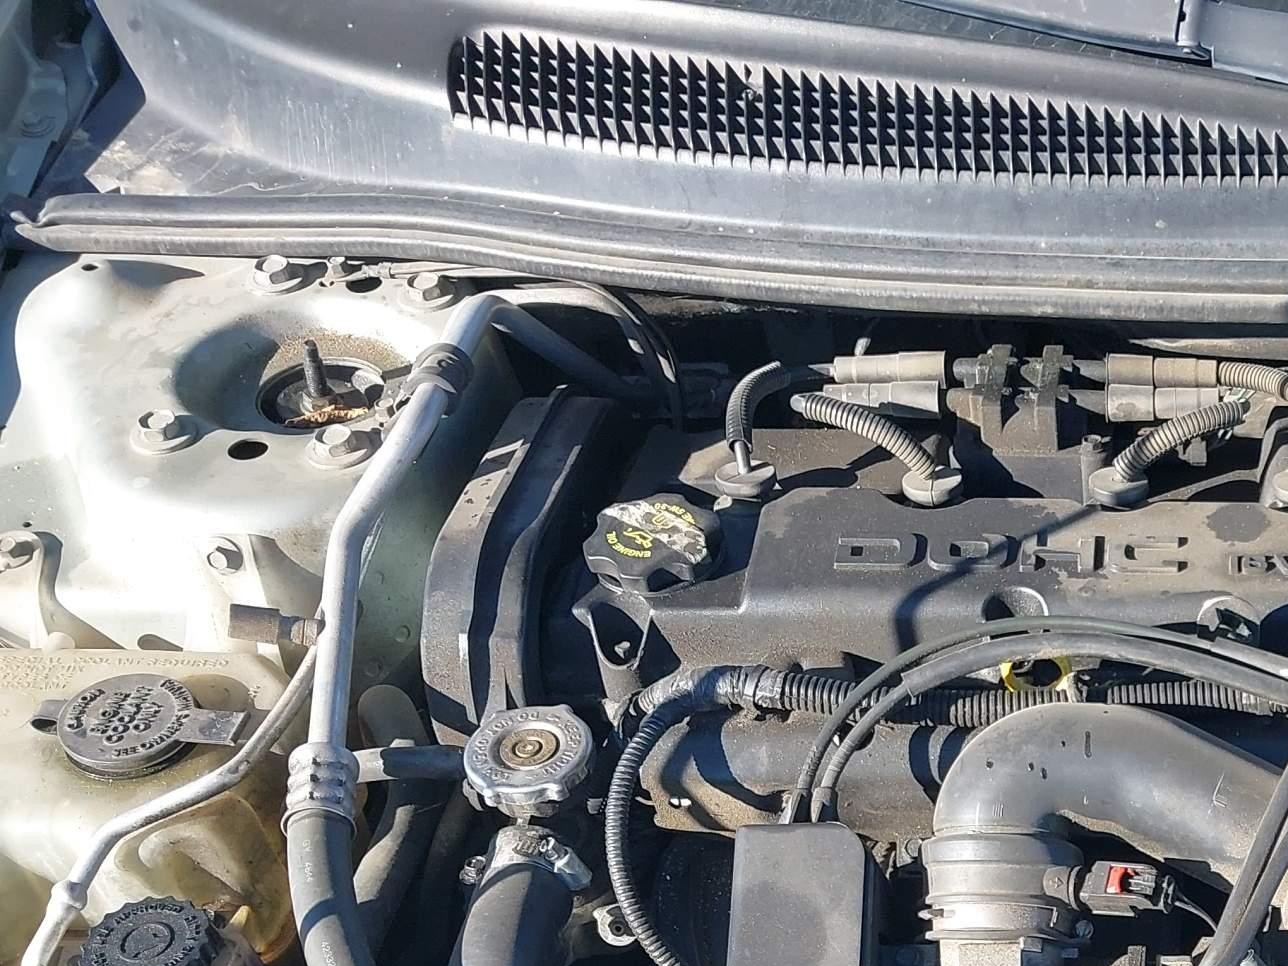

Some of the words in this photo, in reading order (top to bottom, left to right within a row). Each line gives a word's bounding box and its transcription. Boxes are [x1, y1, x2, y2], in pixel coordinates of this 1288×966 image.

[606, 530, 617, 545] OIL
[612, 541, 652, 558] ENGINE
[834, 532, 1189, 574] DOHC
[89, 691, 132, 735] ENGINE
[104, 686, 155, 744] COOLANT
[133, 702, 164, 733] ONLY
